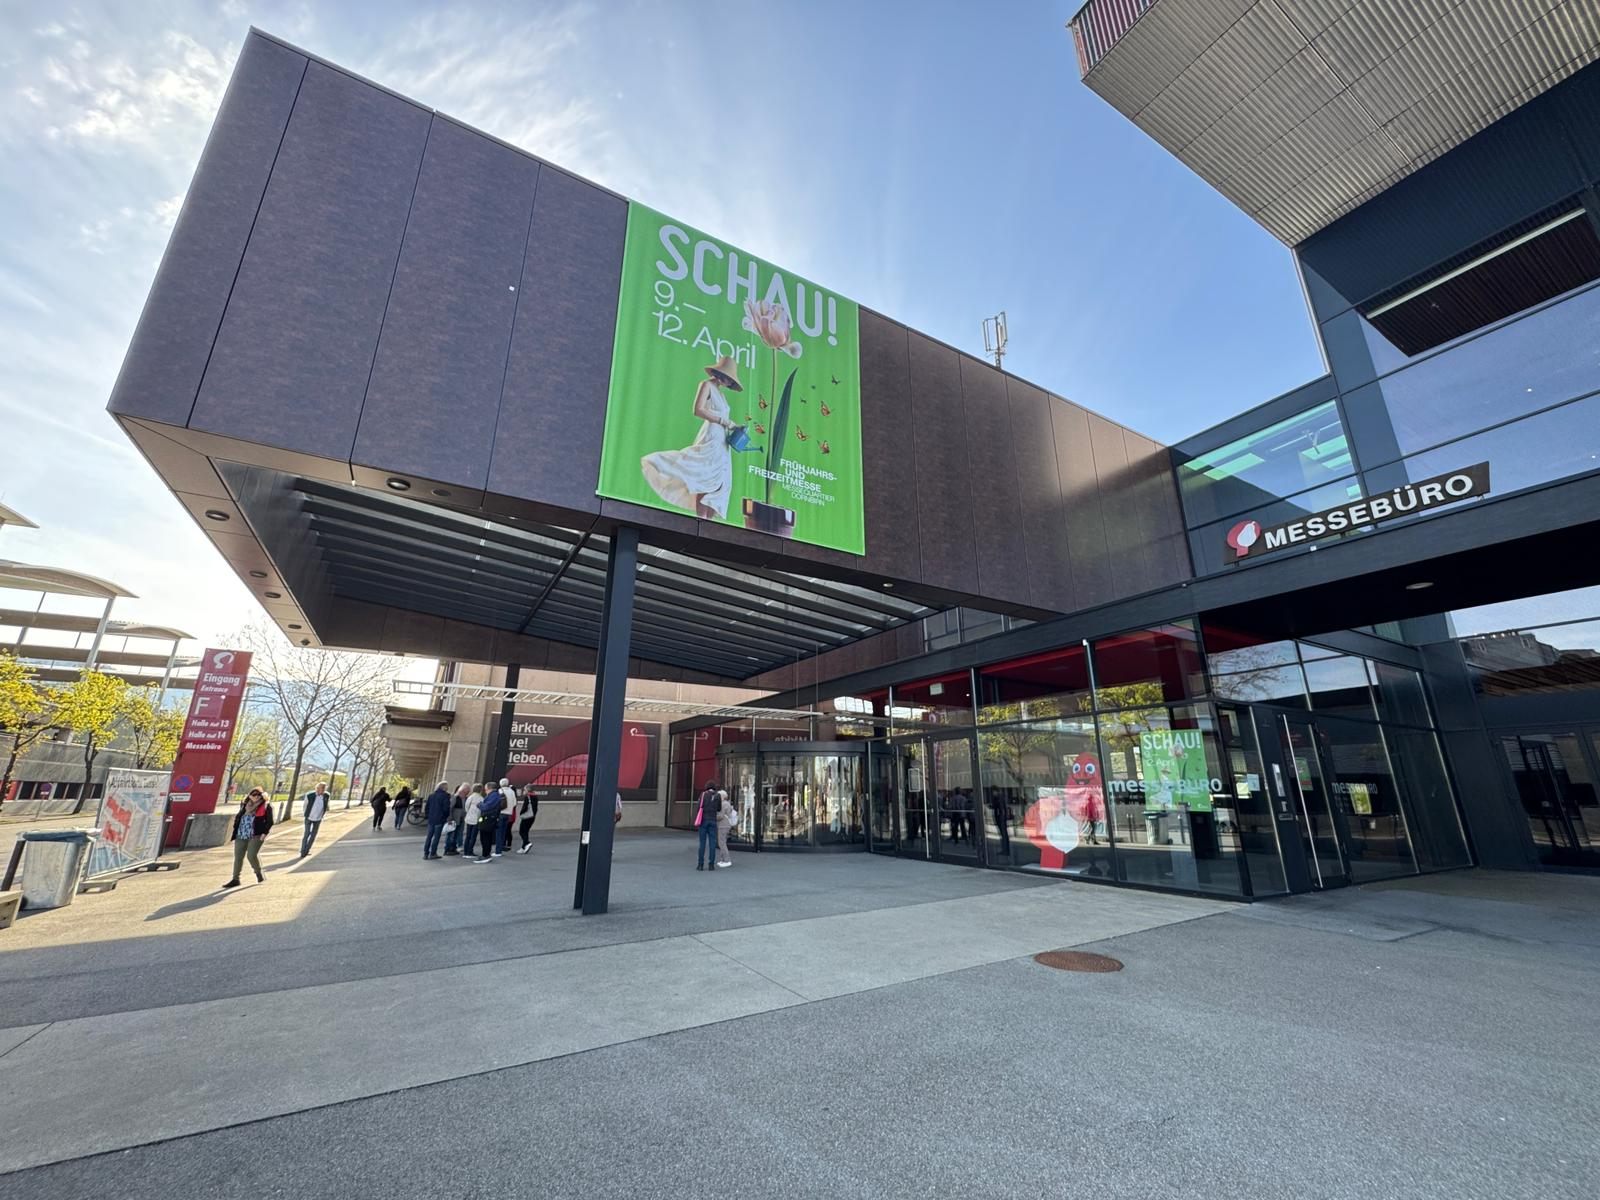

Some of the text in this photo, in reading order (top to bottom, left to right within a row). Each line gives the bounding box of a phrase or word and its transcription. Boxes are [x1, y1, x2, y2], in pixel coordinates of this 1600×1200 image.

[656, 225, 838, 346] SCHAU!
[652, 311, 756, 369] 12. April
[780, 458, 837, 480] FRÜHJAHRS-
[785, 467, 805, 480] UND
[748, 465, 821, 492] FREIZEITMESSE
[1264, 474, 1473, 549] MESSEBÜRO
[203, 673, 240, 686] Eingang
[201, 685, 228, 693] Entrance
[194, 696, 210, 715] F
[221, 720, 230, 728] 13
[511, 721, 548, 734] ärkte.
[218, 731, 226, 739] 14
[1143, 732, 1201, 750] SCHAU!
[185, 742, 221, 750] Messebüro
[509, 737, 529, 748] ve!
